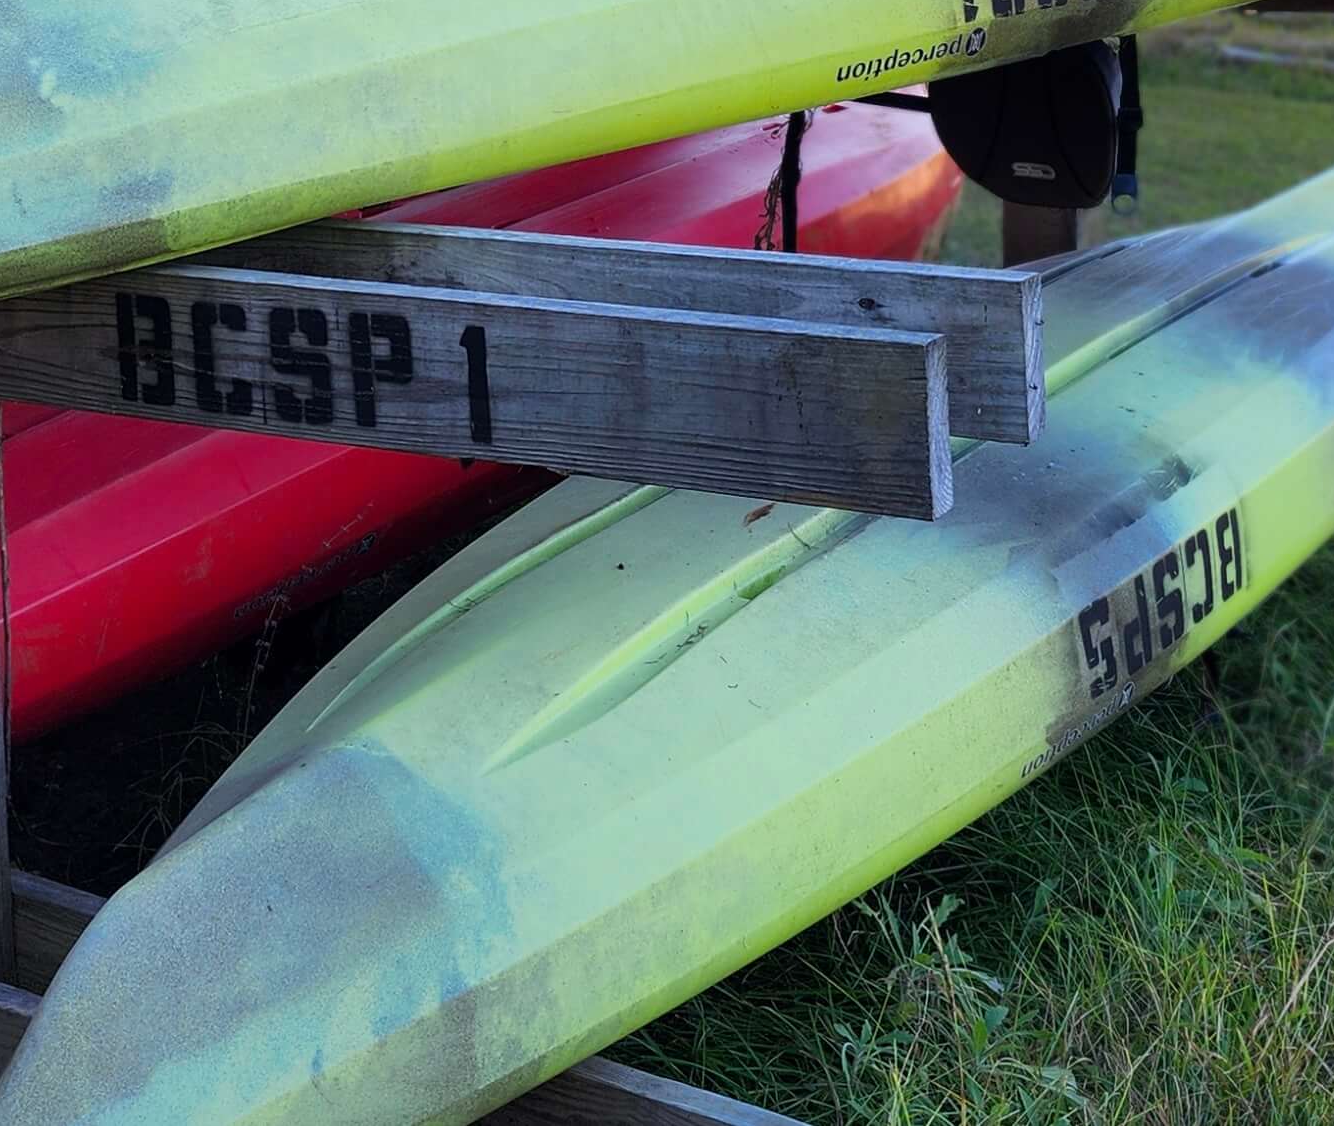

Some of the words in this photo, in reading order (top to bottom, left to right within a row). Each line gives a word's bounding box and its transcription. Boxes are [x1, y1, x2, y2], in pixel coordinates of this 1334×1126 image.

[835, 34, 962, 82] perception
[114, 291, 414, 428] BCSP
[459, 324, 493, 444] 1
